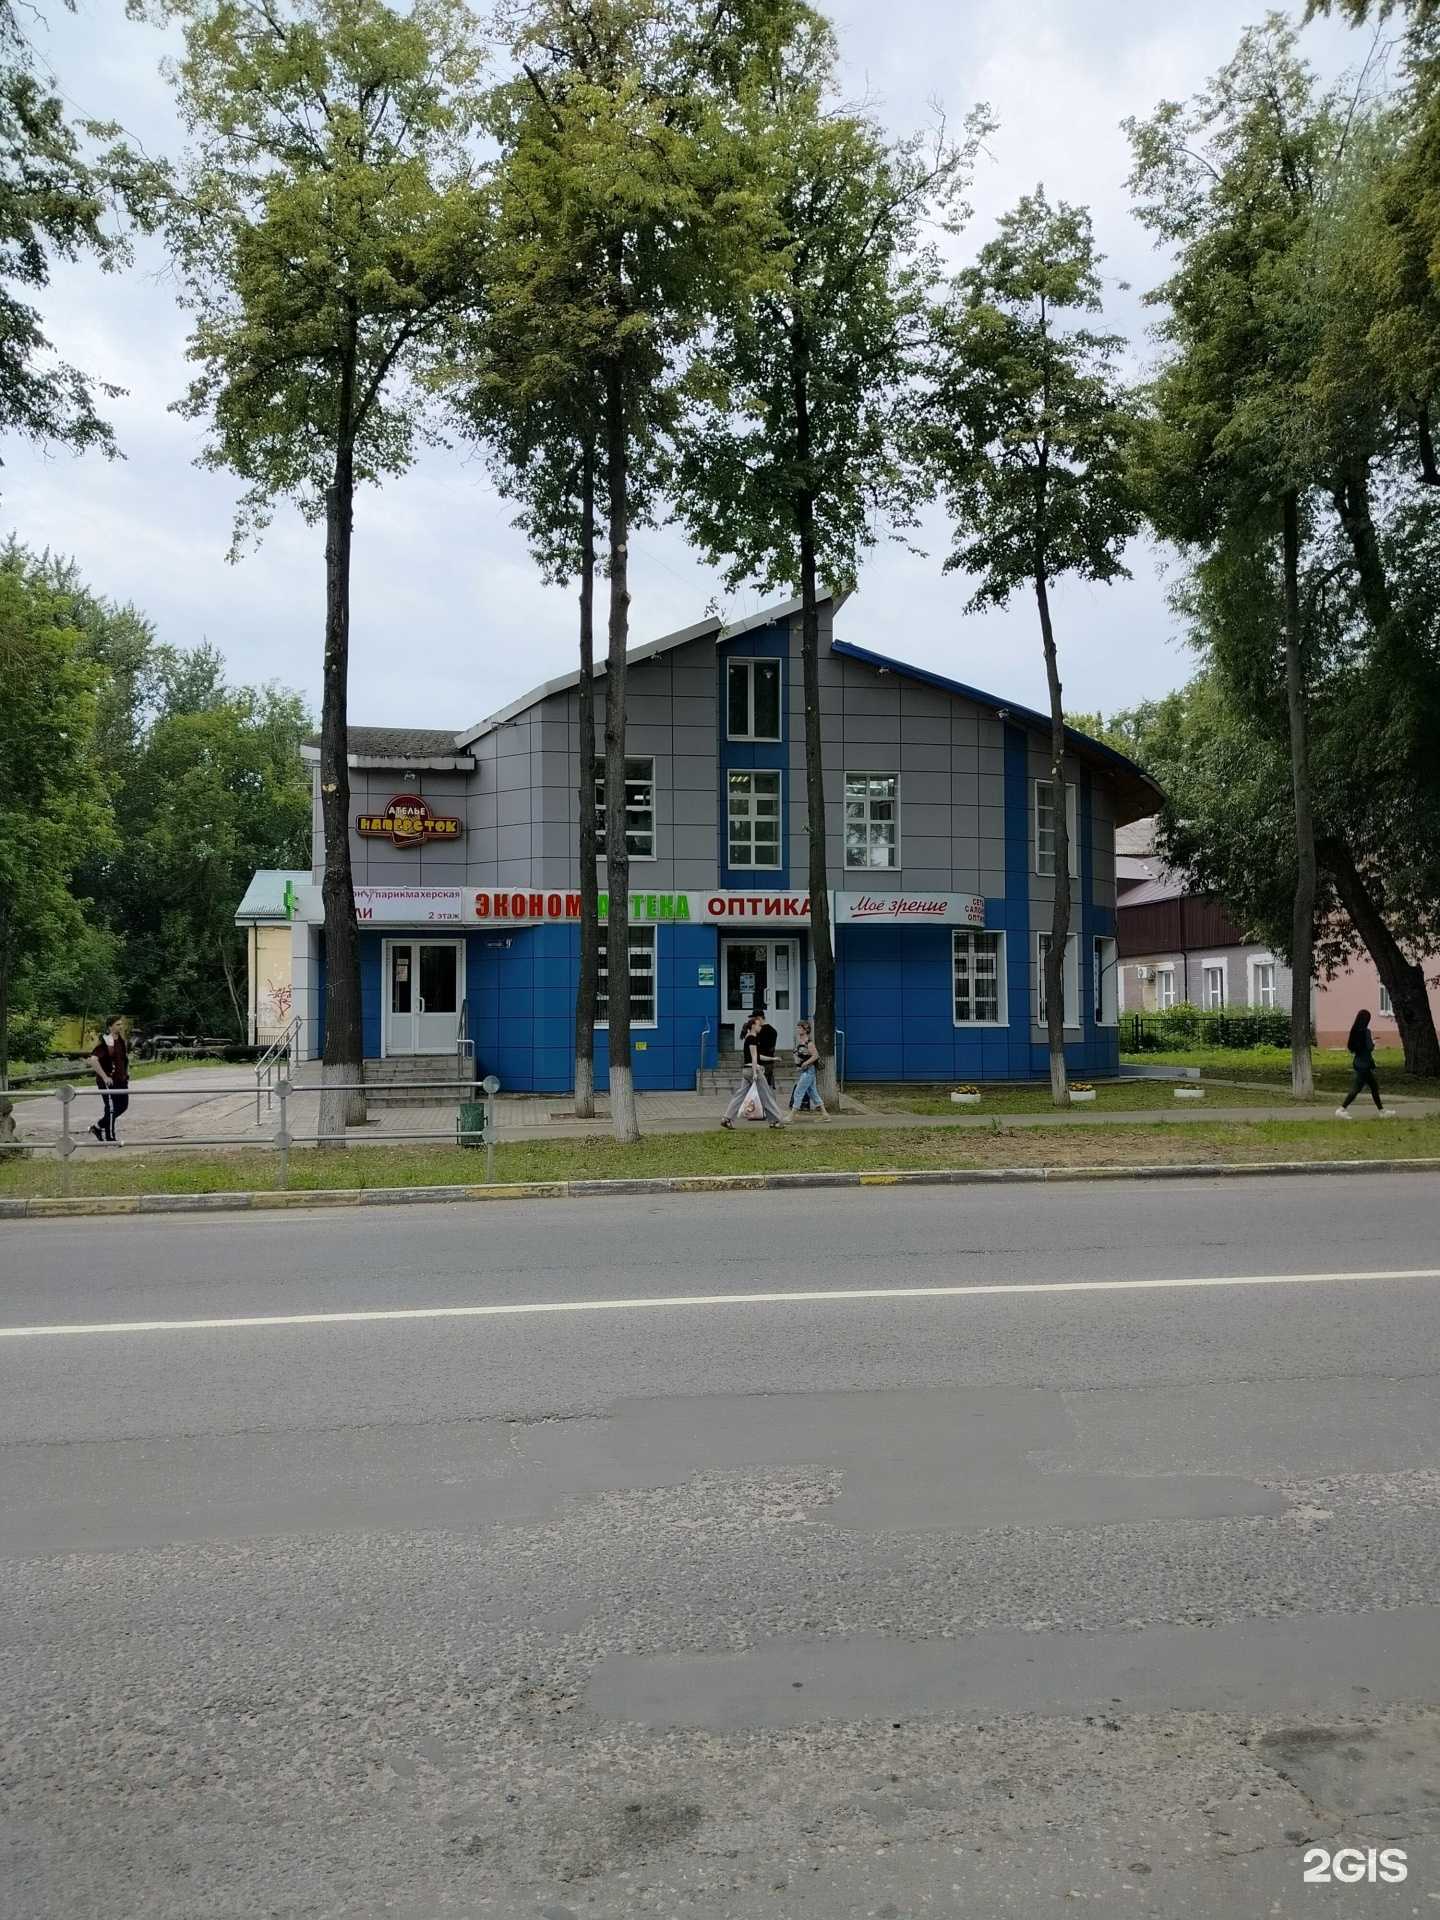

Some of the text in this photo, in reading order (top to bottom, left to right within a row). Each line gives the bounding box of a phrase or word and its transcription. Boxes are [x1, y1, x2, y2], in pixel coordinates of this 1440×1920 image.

[388, 806, 426, 815] АТЕЛЬЕ
[360, 818, 457, 833] НАПЕРСТОК
[375, 890, 460, 900] парикмахерская
[475, 893, 582, 918] ЭКОНОМ
[888, 897, 949, 917] зрение
[428, 911, 461, 920] 2 этаж
